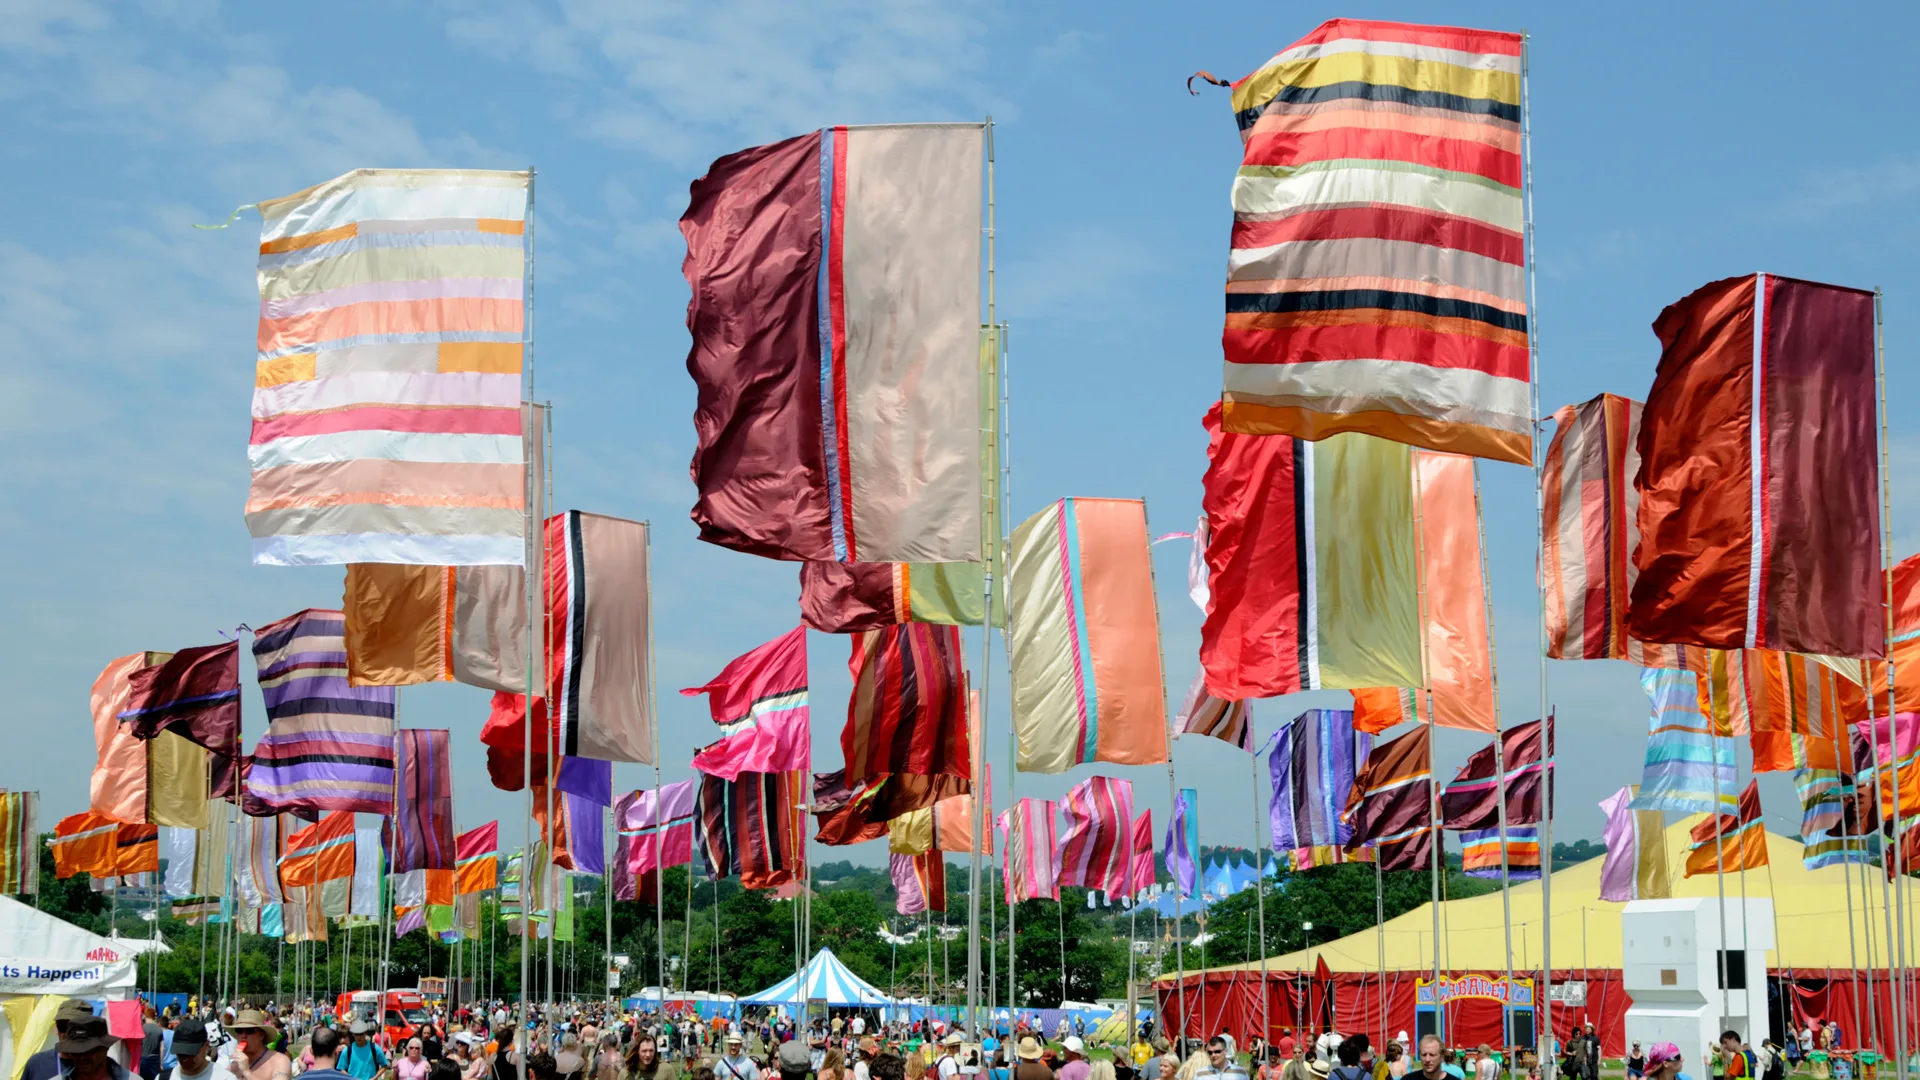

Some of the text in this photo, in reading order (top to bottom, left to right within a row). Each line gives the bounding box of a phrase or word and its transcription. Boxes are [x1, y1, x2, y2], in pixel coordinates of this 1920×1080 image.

[0, 965, 100, 982] ts Happen!
[1432, 976, 1512, 1002] CABARET
